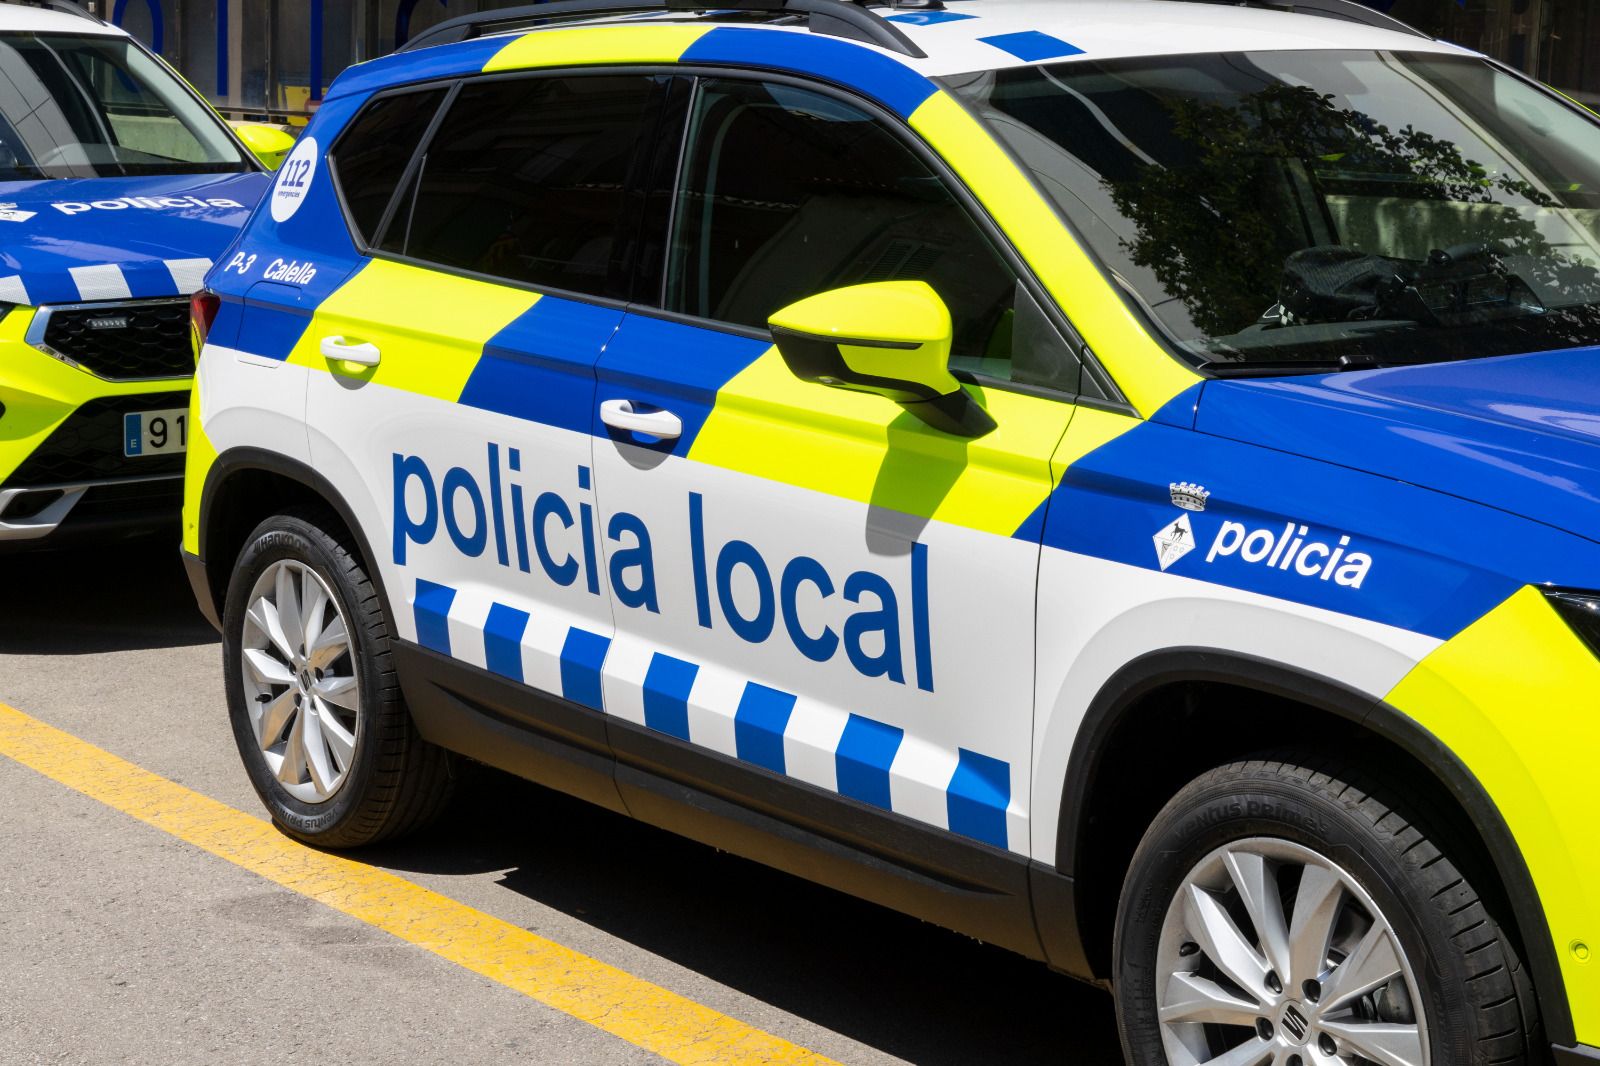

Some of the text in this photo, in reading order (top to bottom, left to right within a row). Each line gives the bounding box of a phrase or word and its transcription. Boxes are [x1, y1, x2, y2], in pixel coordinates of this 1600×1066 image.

[281, 159, 311, 188] 112
[50, 196, 245, 215] policia
[224, 251, 317, 285] P-3 Calella
[130, 439, 137, 448] E
[392, 441, 935, 694] policia local
[1205, 520, 1373, 590] policia
